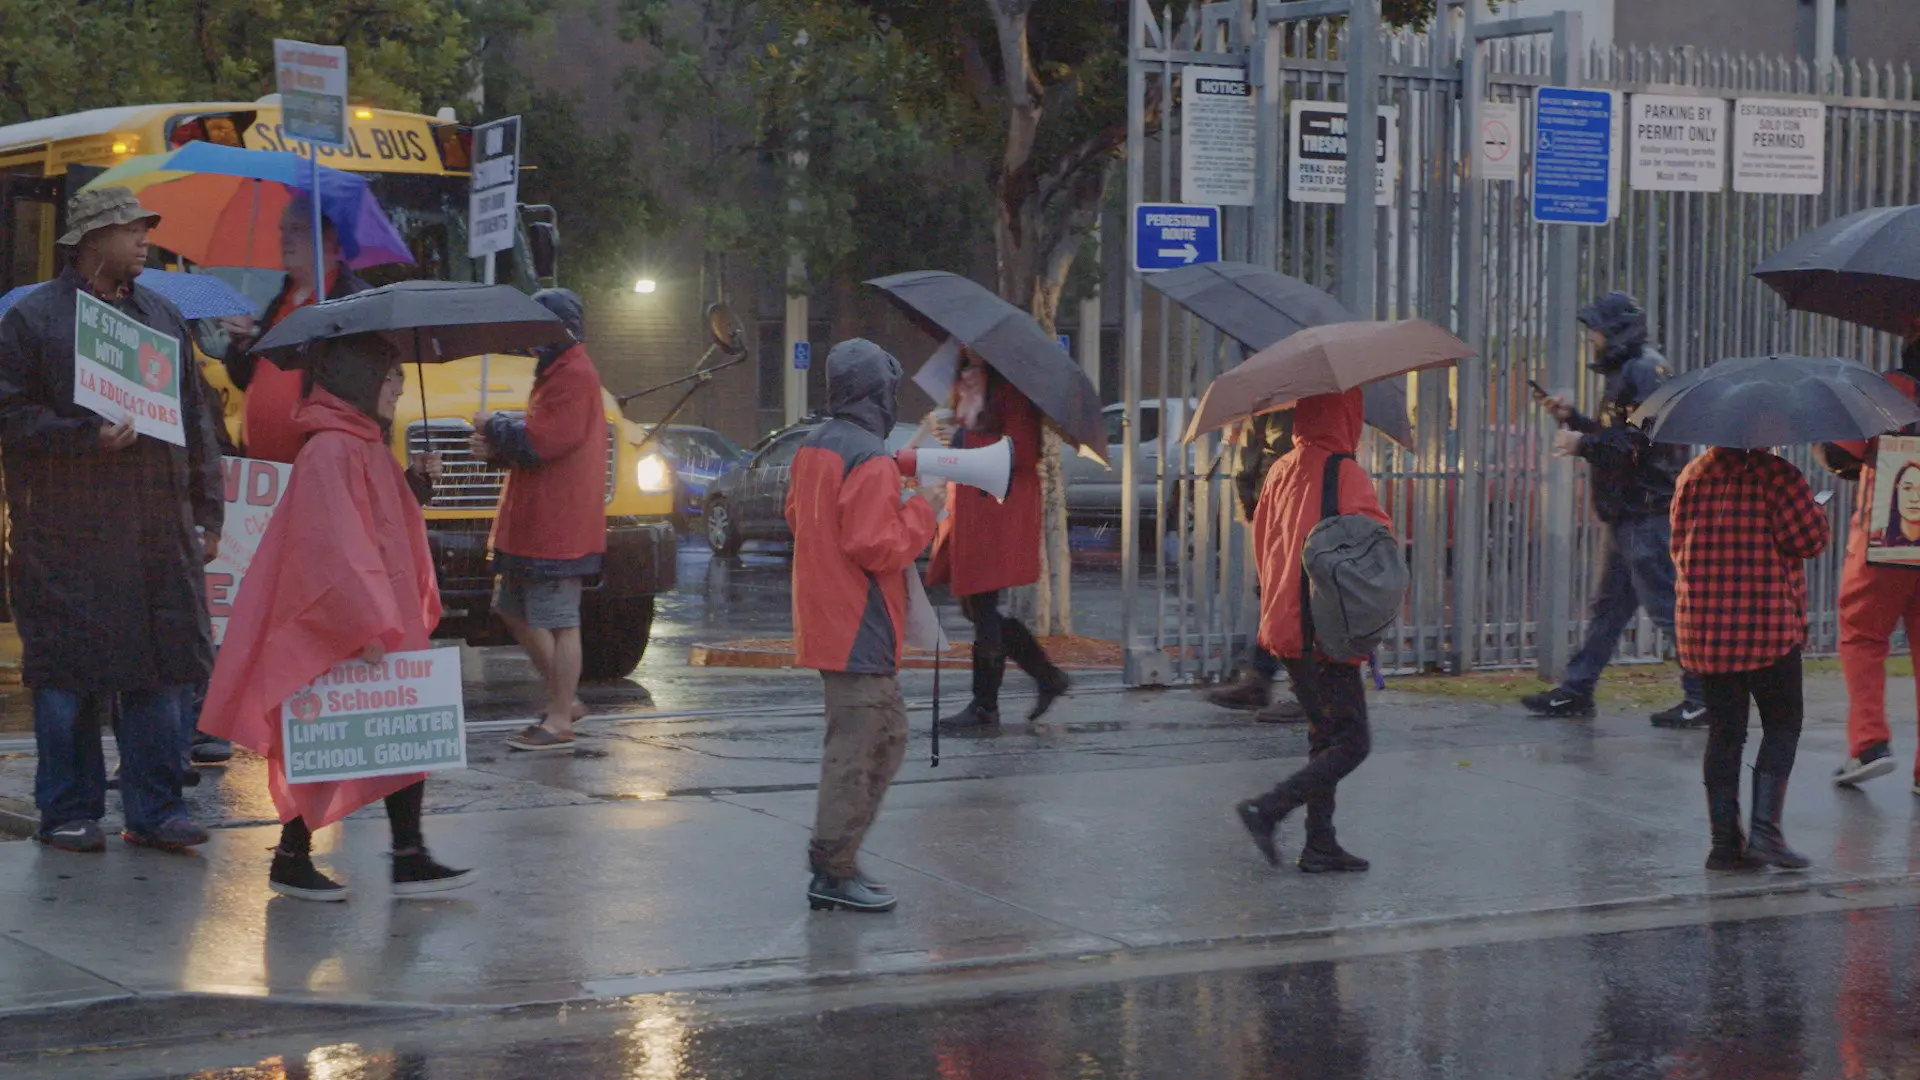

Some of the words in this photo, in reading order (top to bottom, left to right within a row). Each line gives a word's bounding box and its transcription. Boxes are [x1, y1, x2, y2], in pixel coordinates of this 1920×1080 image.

[1200, 80, 1247, 95] NOTICE
[1645, 104, 1695, 121] PARKING
[1698, 106, 1712, 121] BY
[1740, 104, 1819, 119] ESTACIONAMIENTO
[1638, 124, 1684, 141] PERMIT
[1687, 125, 1718, 142] ONLY
[1759, 118, 1781, 131] SOLO
[1783, 120, 1800, 131] CON
[371, 128, 427, 161] BUS
[1752, 132, 1805, 149] PERMISO
[1299, 163, 1325, 174] PENAL
[1300, 174, 1323, 185] STATE
[1326, 175, 1336, 186] OF
[1145, 213, 1210, 228] PEDESTRIAN
[1161, 227, 1197, 241] ROUTE
[81, 302, 99, 329] WE
[101, 312, 140, 350] STAND
[95, 338, 124, 370] WITH
[79, 366, 96, 392] LA
[100, 376, 178, 426] EDUCATORS
[394, 658, 434, 679] Our
[327, 685, 419, 713] Schools
[292, 721, 349, 744] LIMIT
[364, 710, 454, 738] CHARTER
[291, 746, 368, 772] SCHOOL
[374, 737, 459, 765] GROWTH
